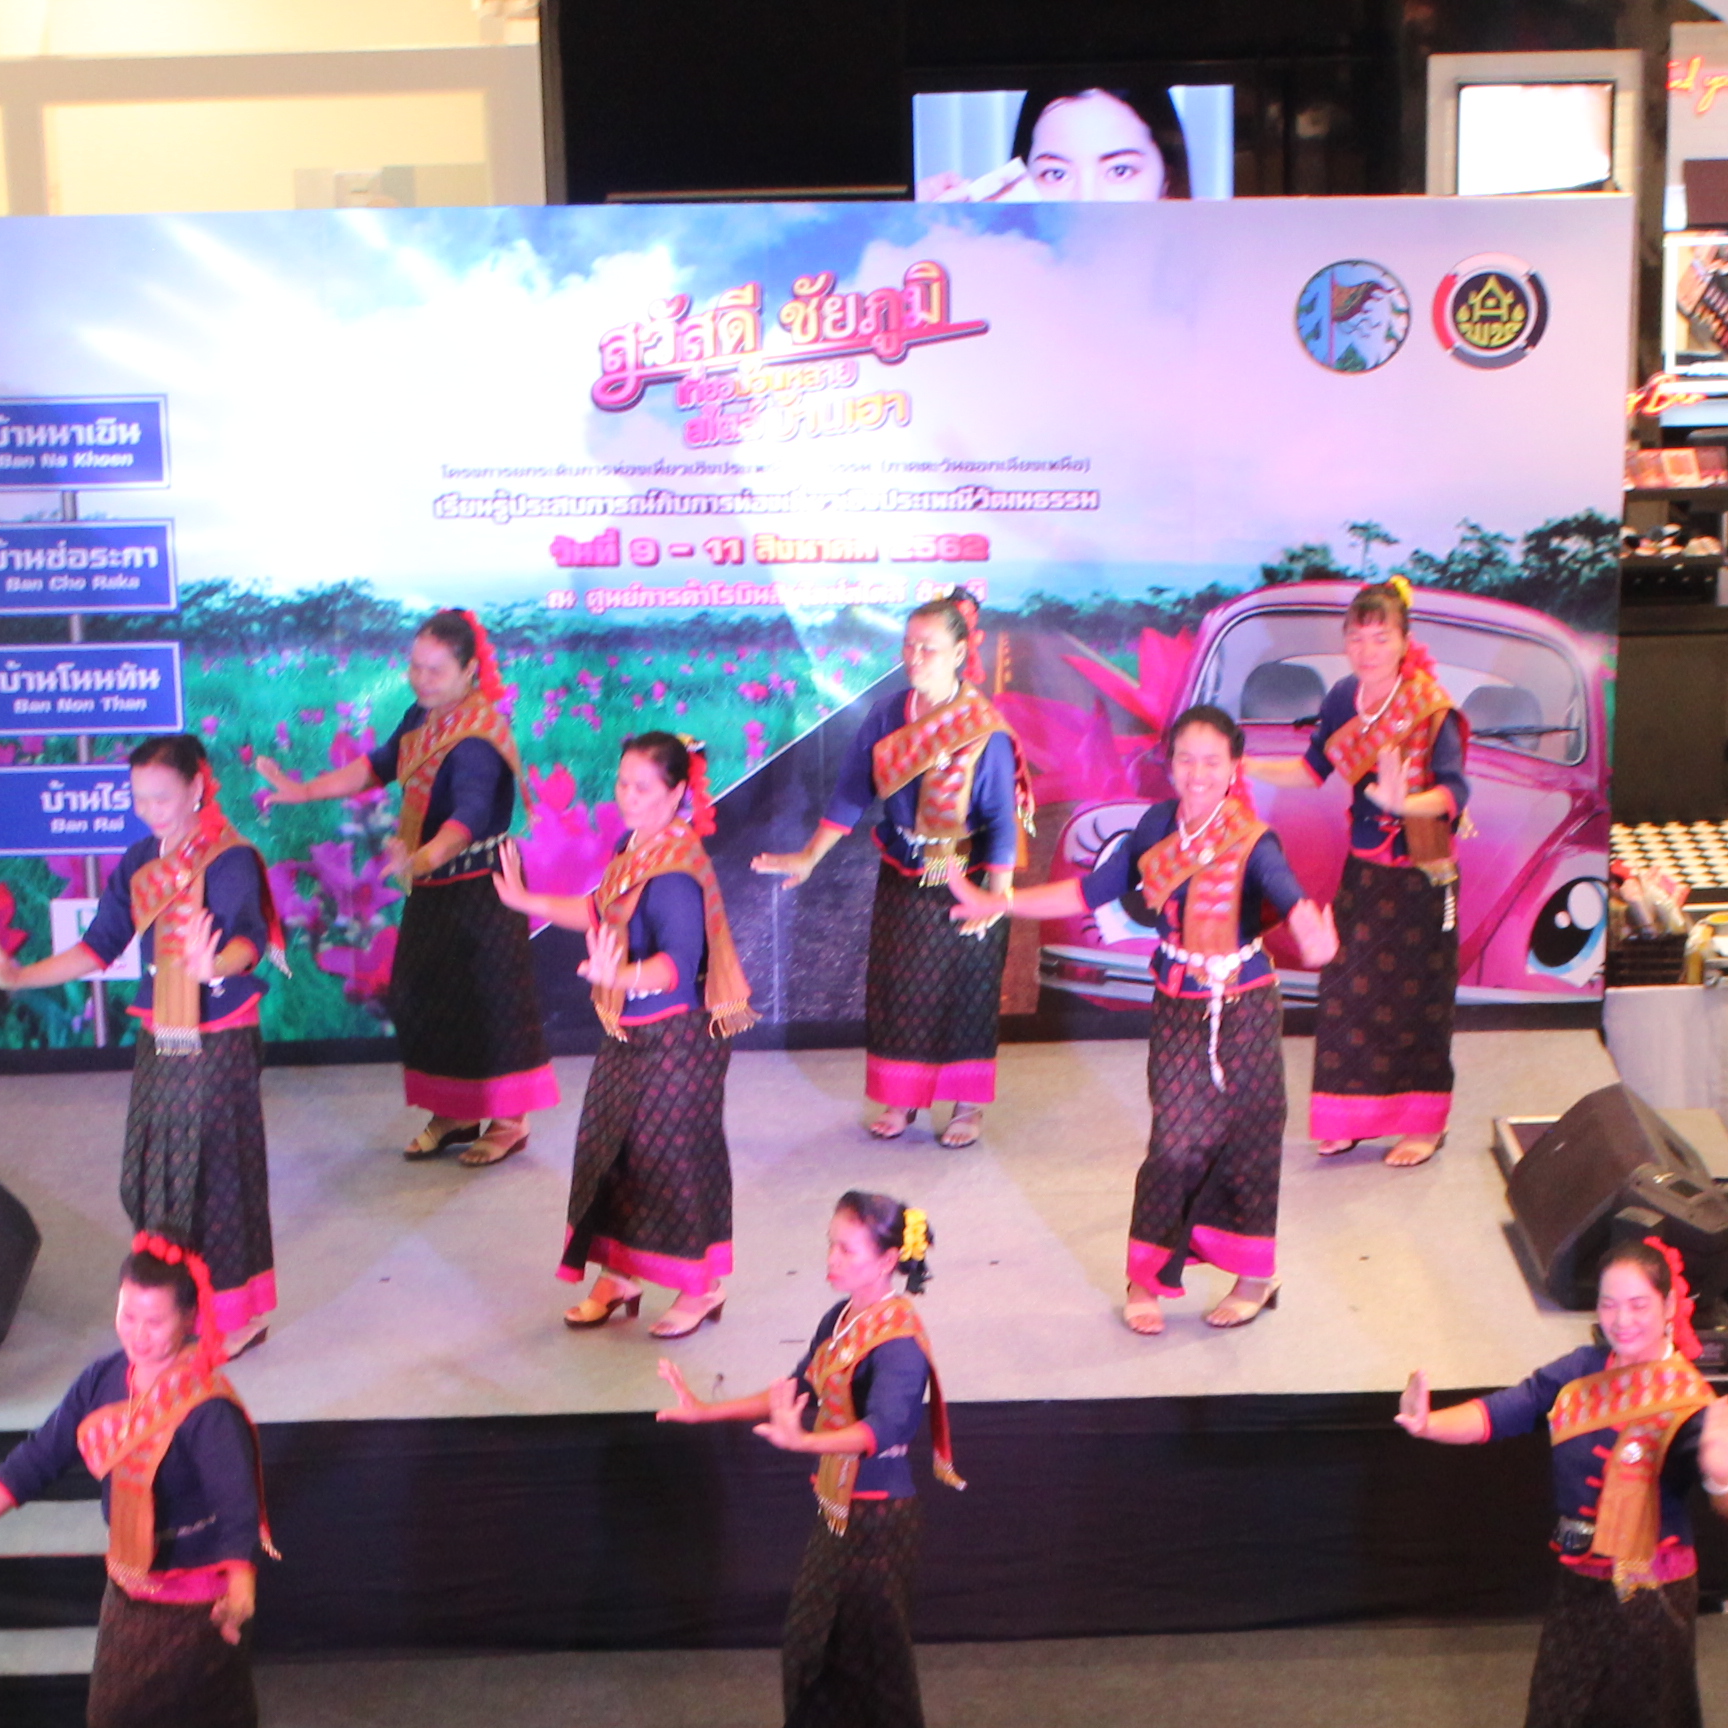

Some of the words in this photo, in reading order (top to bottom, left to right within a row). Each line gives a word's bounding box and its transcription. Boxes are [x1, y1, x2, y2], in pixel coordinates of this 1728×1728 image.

[591, 281, 762, 411] สวัสดี
[779, 261, 950, 365] ชัยภูมิ
[40, 453, 68, 468] Na
[550, 527, 619, 567] วันที่
[629, 537, 660, 566] 9
[703, 537, 745, 564] 11
[890, 533, 990, 562] 2562
[5, 577, 43, 592] Ban
[49, 575, 86, 591] Cho
[92, 574, 141, 591] Raka
[13, 699, 52, 714] Ban
[56, 698, 95, 712] Non
[101, 695, 148, 712] Than
[40, 780, 132, 813] บ้านไร่
[50, 818, 88, 833] Ban
[93, 816, 125, 832] Rai
